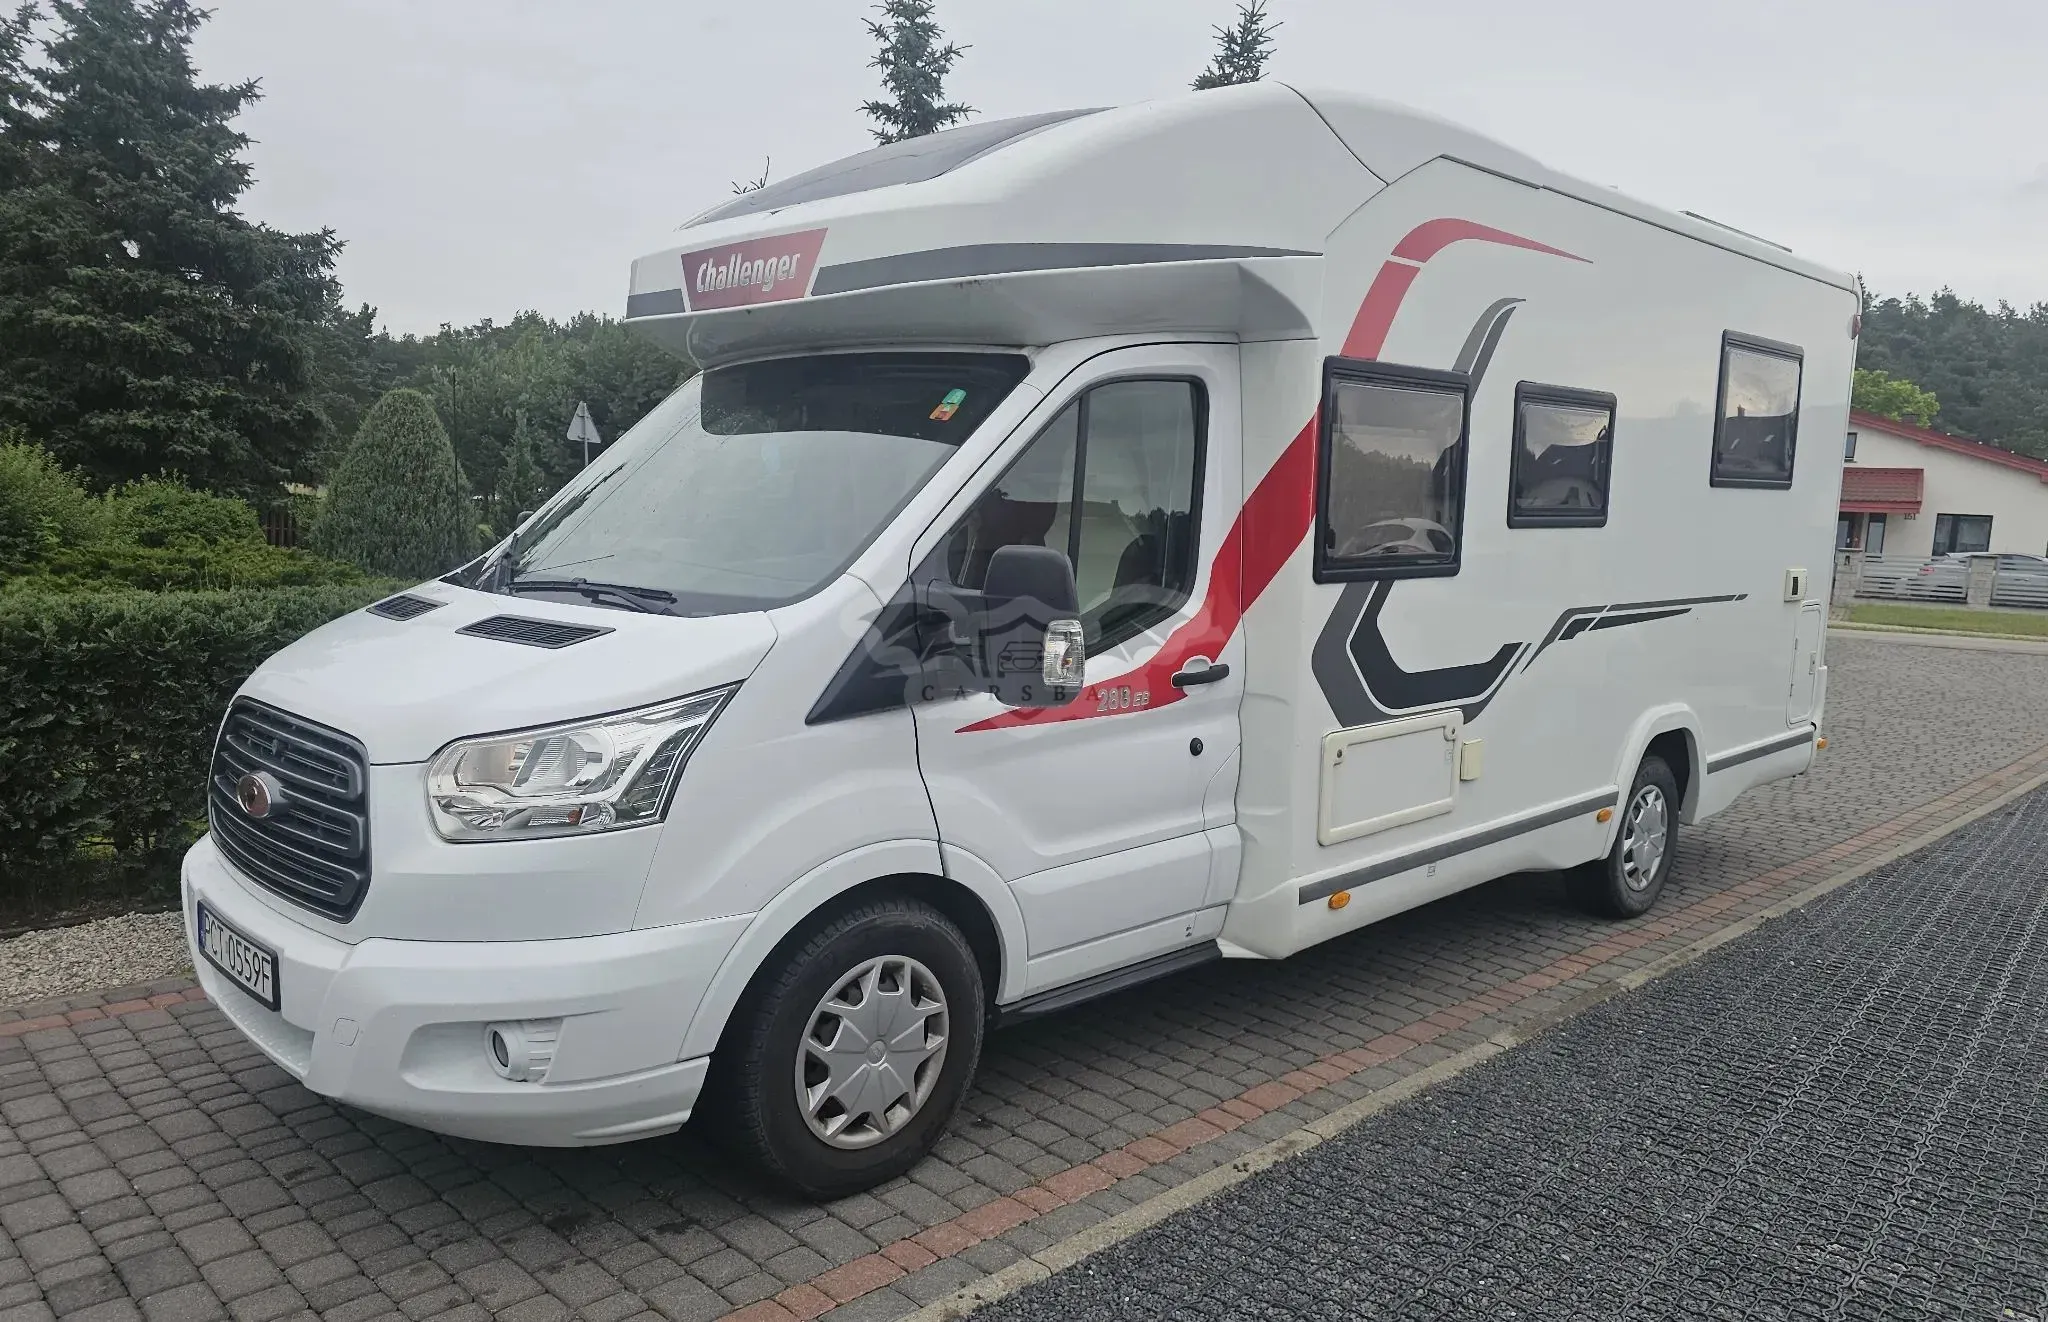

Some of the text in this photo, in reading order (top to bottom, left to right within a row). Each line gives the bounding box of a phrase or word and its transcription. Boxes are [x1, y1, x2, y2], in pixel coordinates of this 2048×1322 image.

[697, 253, 801, 292] Challenger
[204, 912, 271, 993] PCT 0559F
